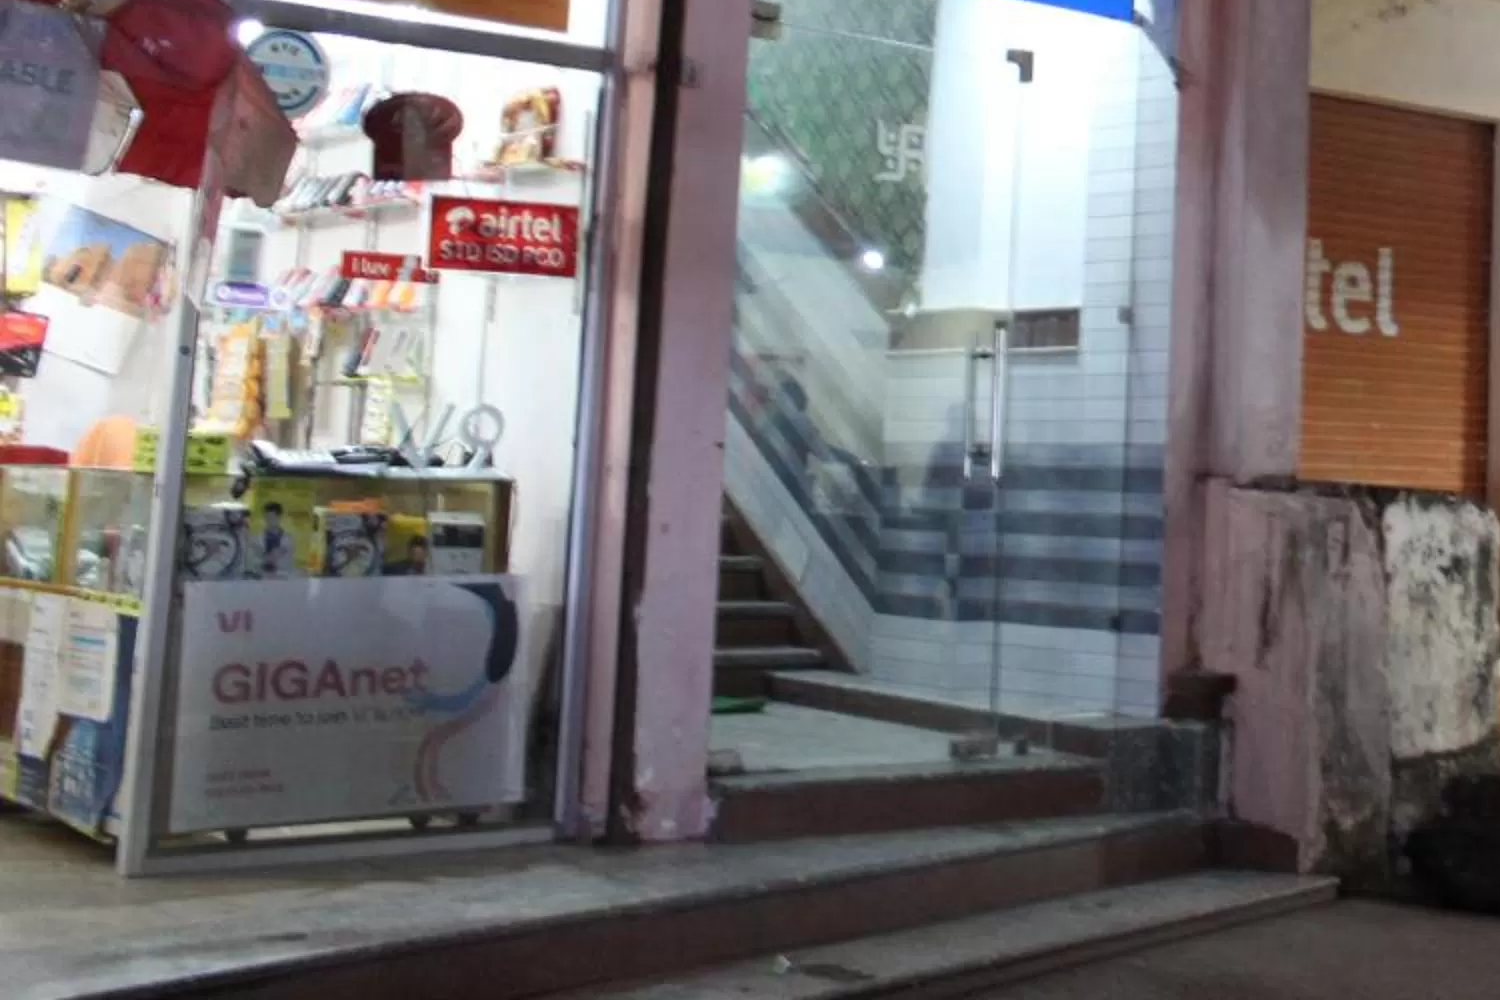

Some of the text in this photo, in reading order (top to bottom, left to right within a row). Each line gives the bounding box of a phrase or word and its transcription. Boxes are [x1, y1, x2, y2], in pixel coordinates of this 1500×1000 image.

[478, 205, 562, 244] airtel
[440, 238, 481, 261] STD
[211, 656, 430, 704] GIGAnet
